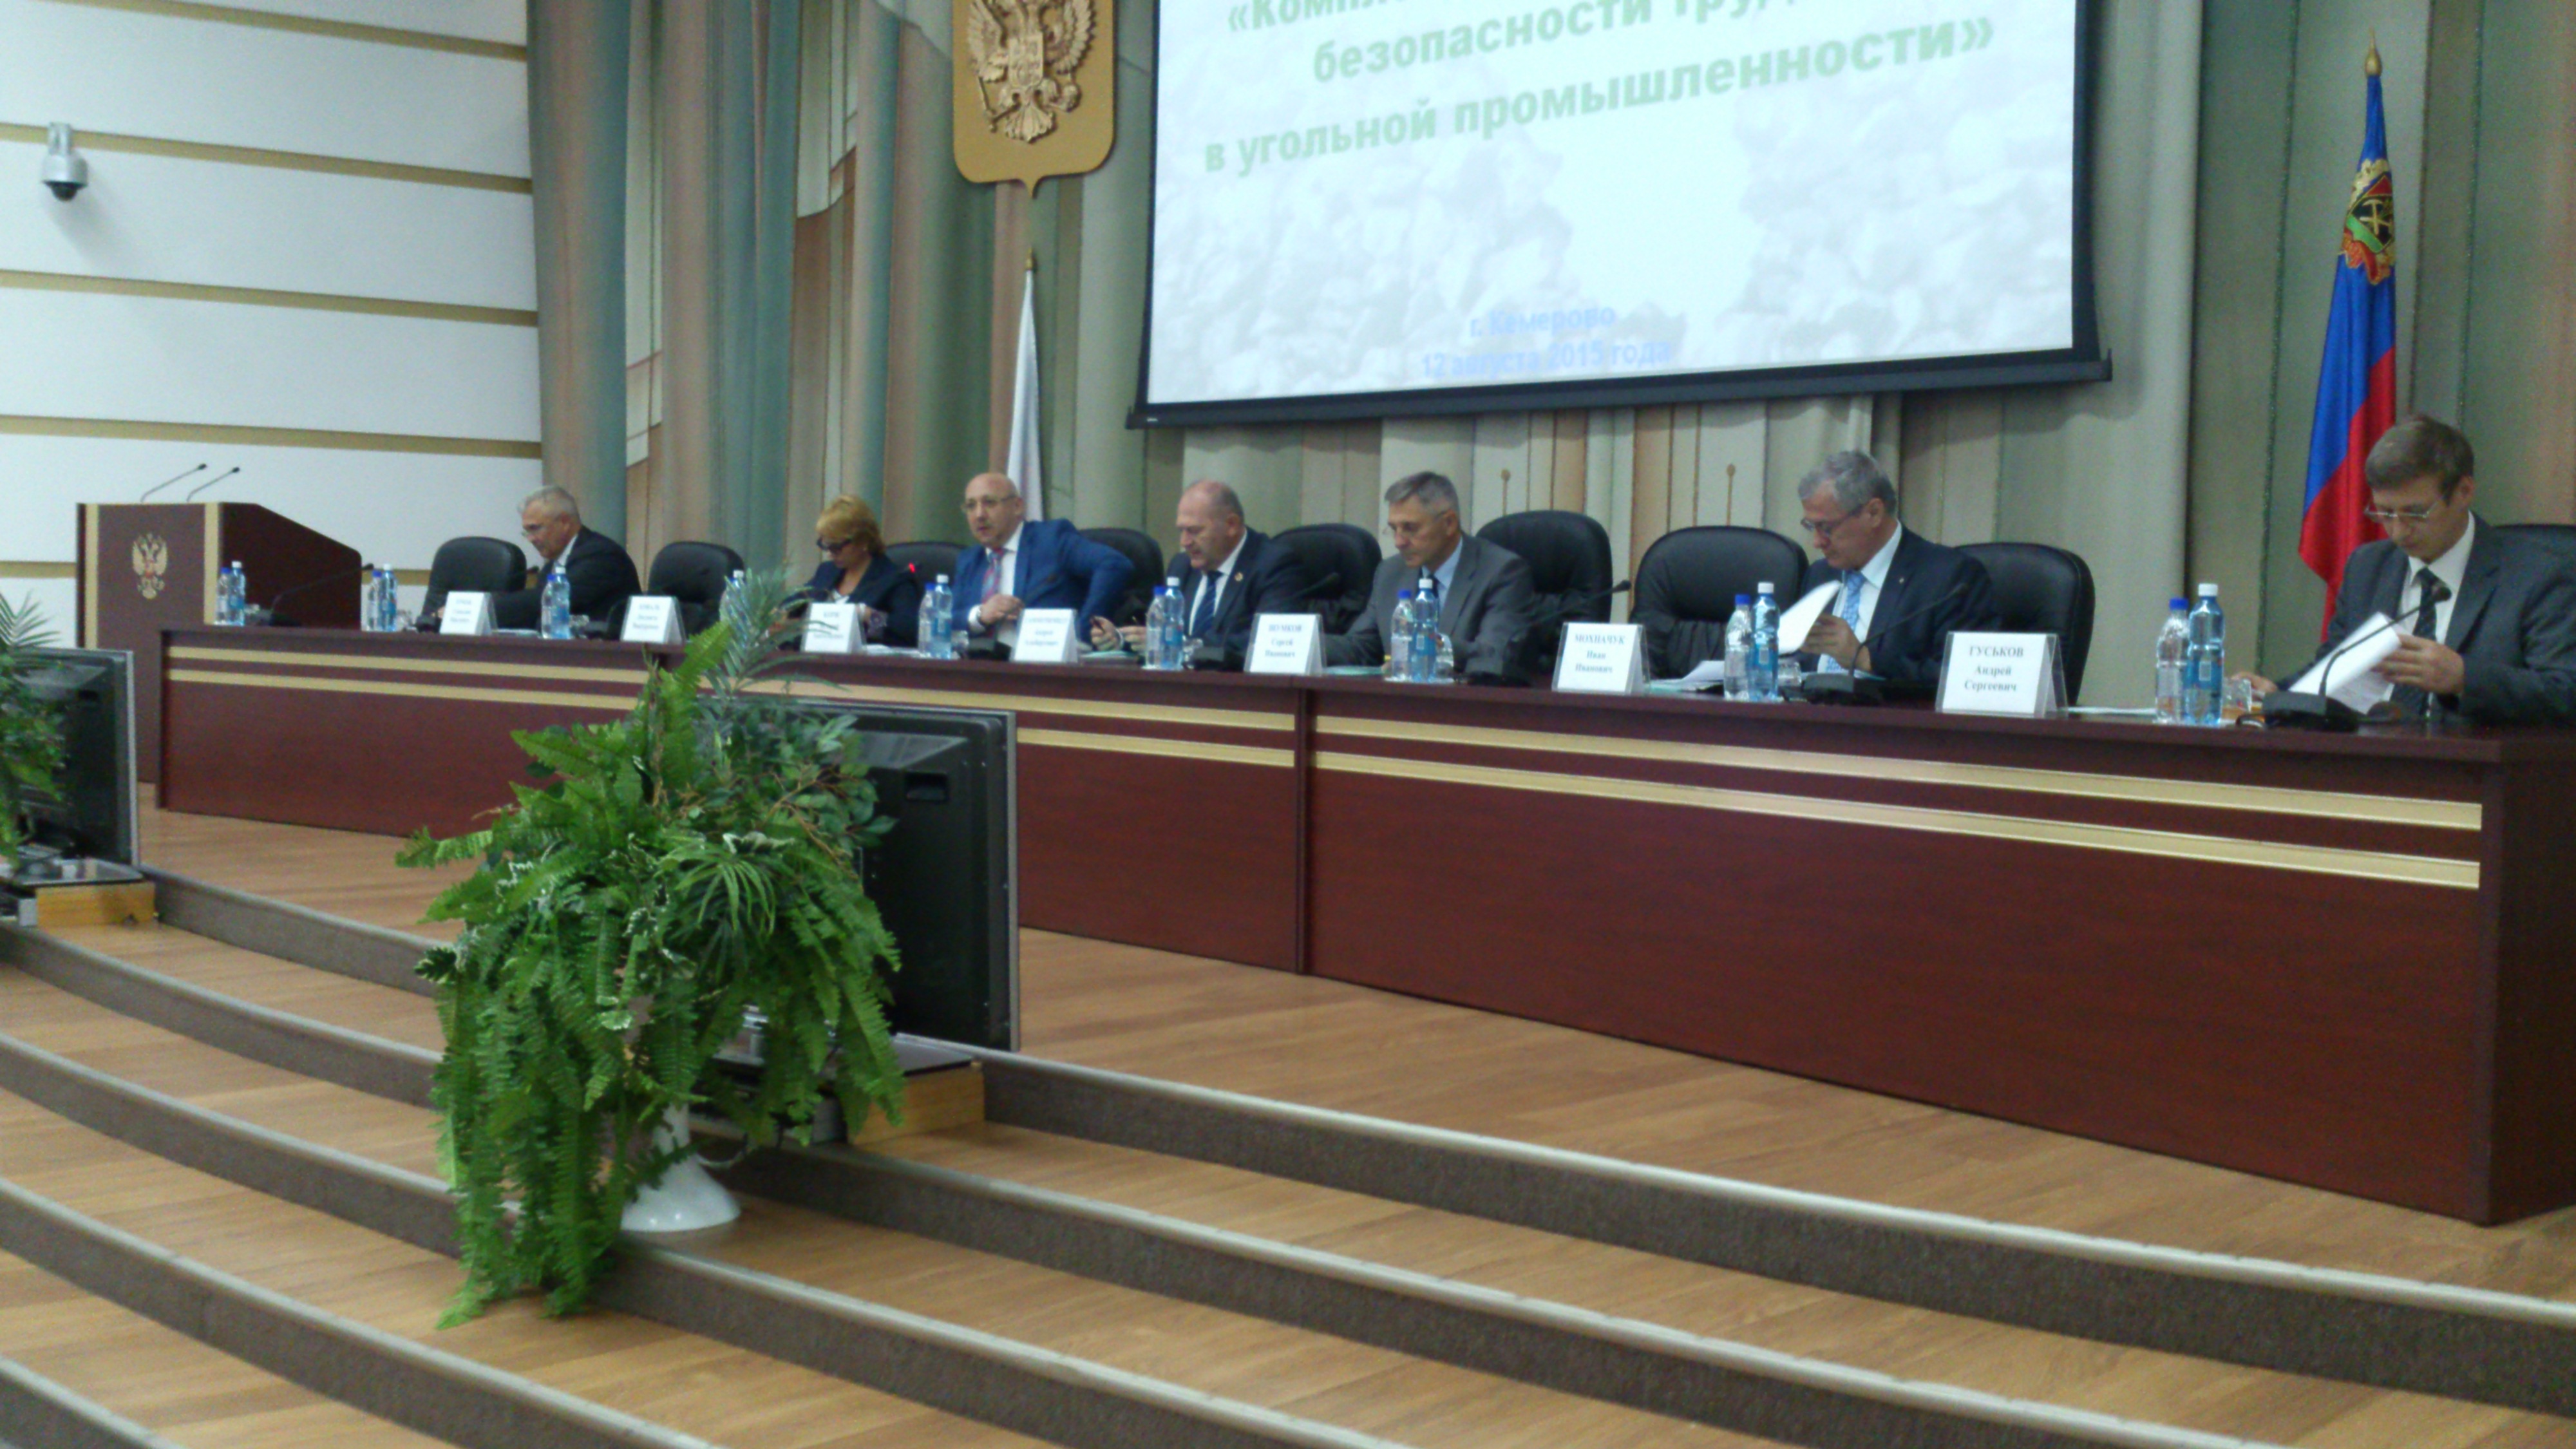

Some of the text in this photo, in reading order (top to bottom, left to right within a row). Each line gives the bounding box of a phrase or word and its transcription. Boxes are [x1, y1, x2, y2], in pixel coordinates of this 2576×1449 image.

[1313, 0, 1654, 82] безопасности
[1206, 16, 1994, 178] в угольной промышленности»
[1489, 307, 1616, 338] Кемерово
[1450, 350, 1540, 379] августа
[1548, 340, 1604, 369] 2015
[1611, 341, 1671, 368] года
[1969, 645, 2024, 658] ГУСЬКОВ
[1964, 679, 2017, 693] Сергеевич
[1974, 665, 2012, 677] Андрей
